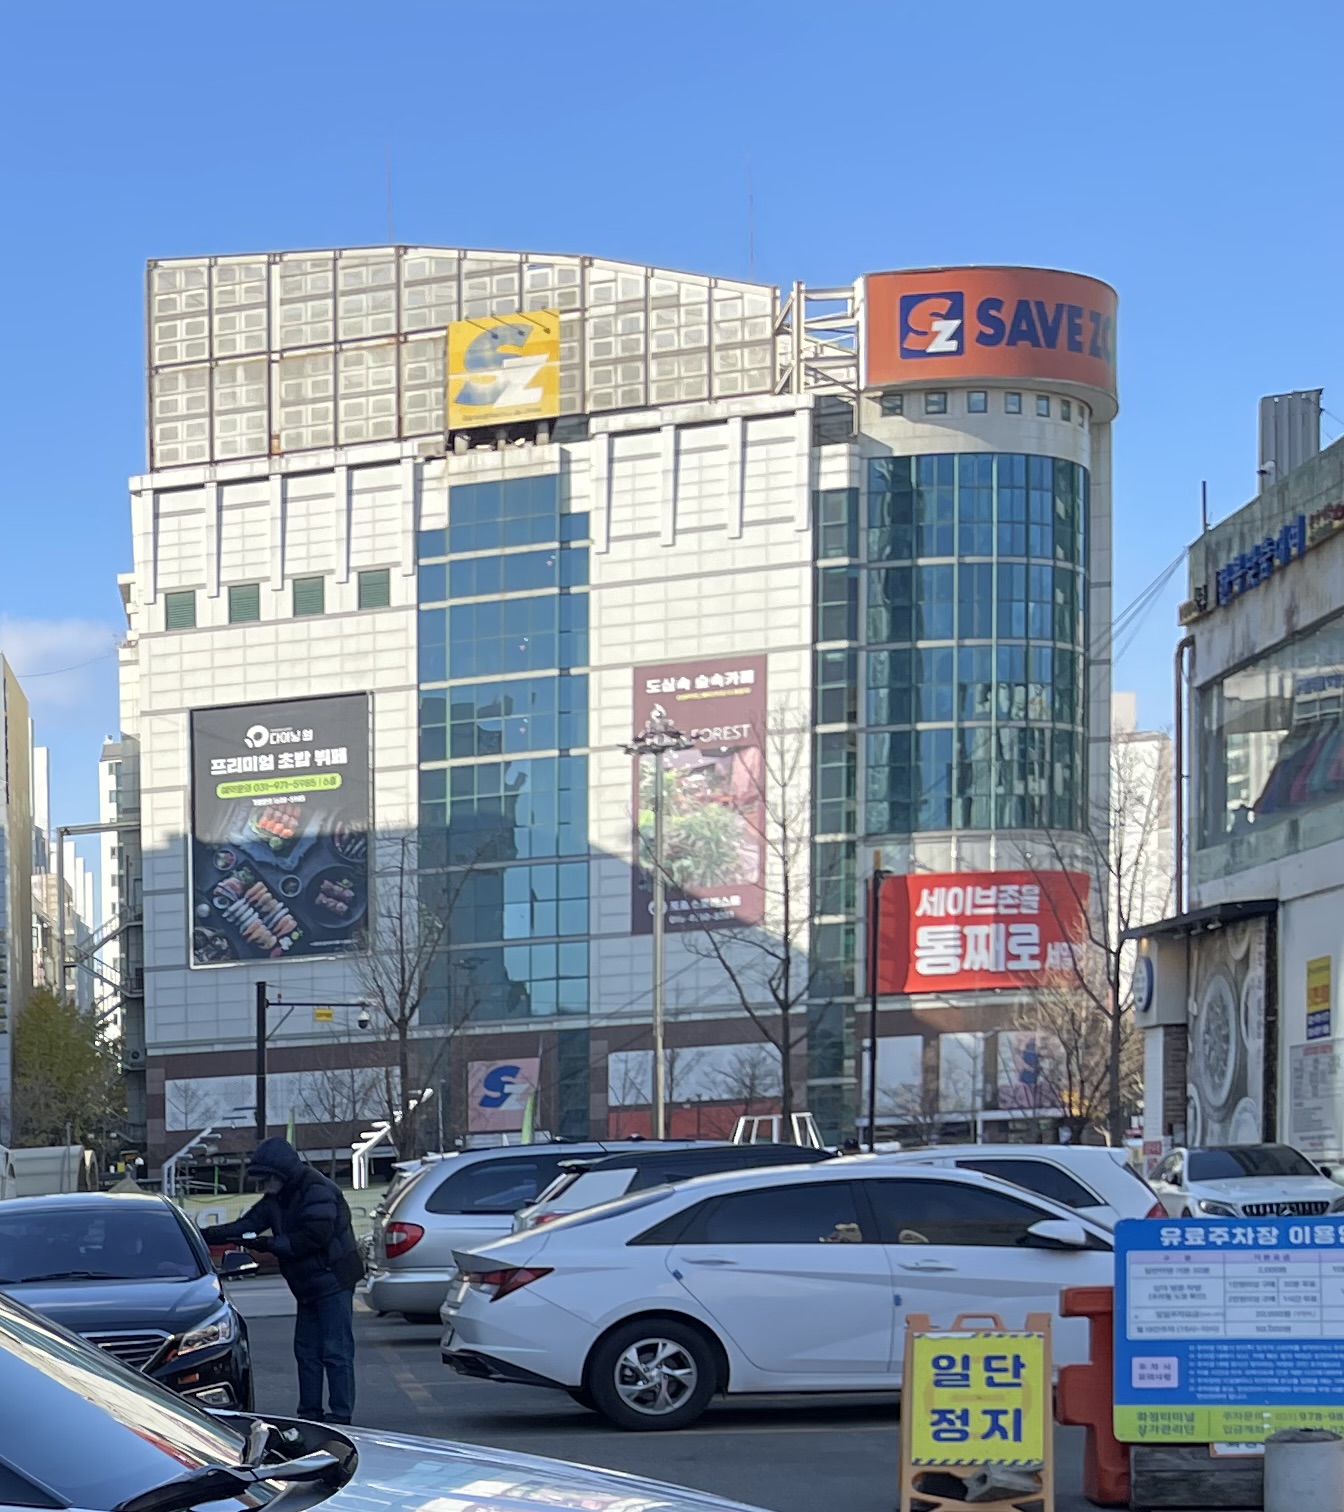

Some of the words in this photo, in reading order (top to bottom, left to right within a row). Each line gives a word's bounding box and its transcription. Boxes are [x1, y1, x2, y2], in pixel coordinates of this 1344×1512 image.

[976, 297, 1084, 354] SAVE
[210, 754, 275, 776] 프리미엄
[278, 751, 311, 770] 초밥
[314, 747, 348, 767] 뷔페
[915, 884, 1041, 917] 세이브존을
[914, 922, 1041, 975] 통째로
[1160, 1226, 1280, 1247] 유료주차장
[931, 1354, 1026, 1388] 일단
[930, 1408, 1022, 1443] 정지
